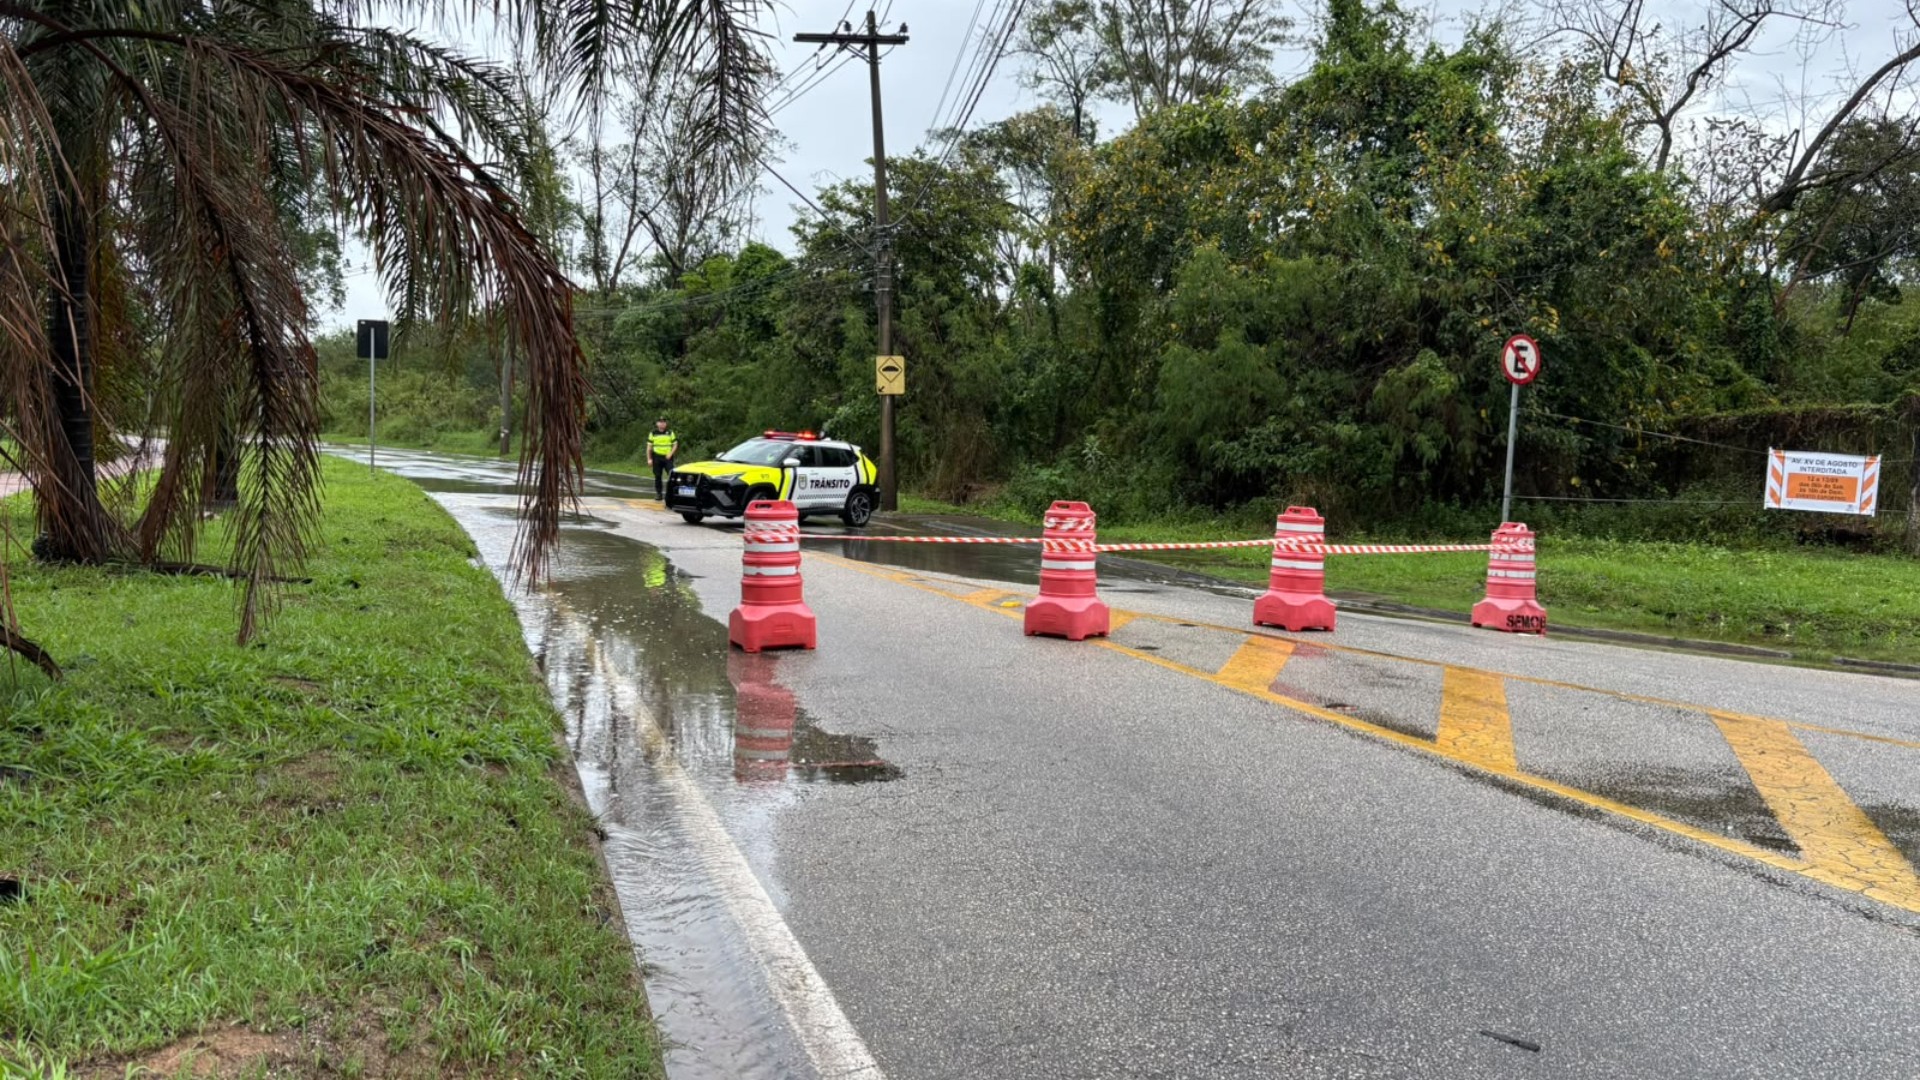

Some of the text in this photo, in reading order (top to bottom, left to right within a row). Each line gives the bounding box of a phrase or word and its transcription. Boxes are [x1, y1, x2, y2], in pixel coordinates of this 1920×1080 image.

[1513, 345, 1528, 373] E
[1827, 460, 1858, 468] AGOSTO
[810, 477, 851, 489] TRÂNSITO
